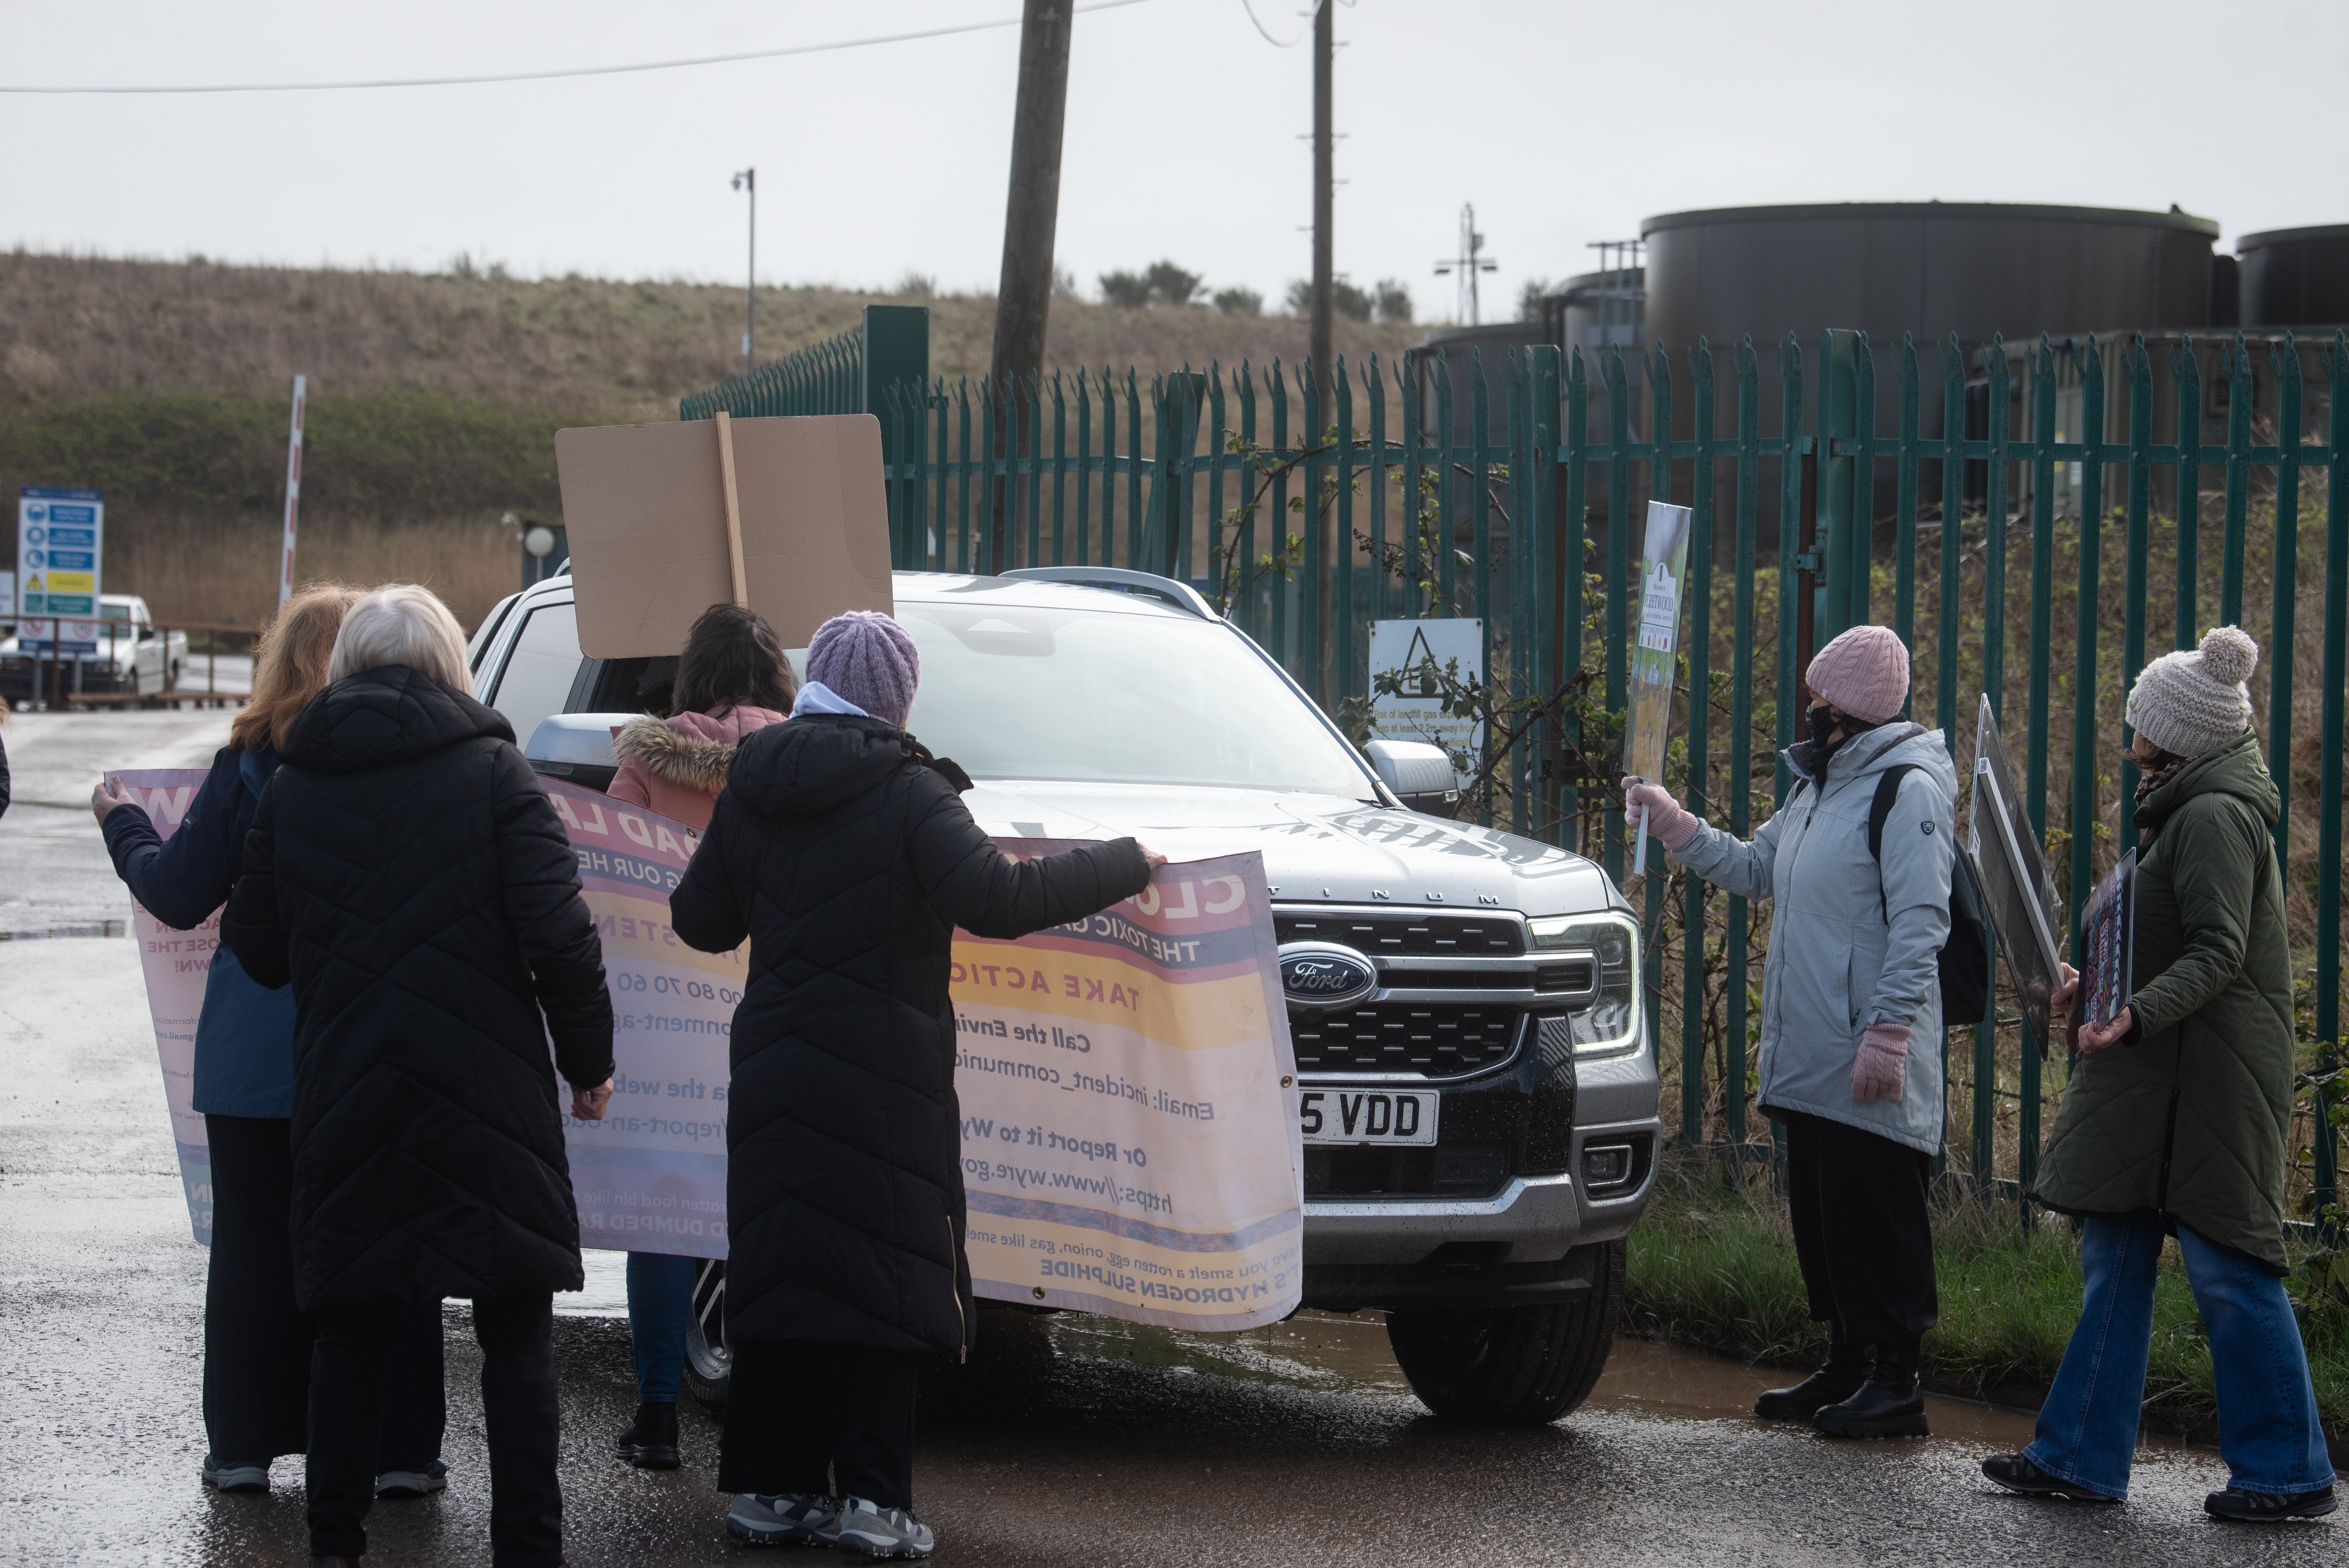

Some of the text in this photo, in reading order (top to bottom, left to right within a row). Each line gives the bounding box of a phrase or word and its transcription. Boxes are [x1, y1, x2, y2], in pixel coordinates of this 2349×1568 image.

[1653, 583, 1663, 591] Welcome
[1644, 594, 1673, 611] FLEETWOOD
[1374, 709, 1387, 719] Risk
[1389, 709, 1396, 719] of
[1398, 709, 1421, 719] landfill
[1424, 711, 1437, 721] gas
[1399, 724, 1417, 733] least
[1419, 724, 1437, 733] 2.2m
[1440, 726, 1458, 735] away
[1460, 724, 1477, 733] from
[1289, 962, 1348, 989] Ford
[1339, 1093, 1420, 1136] VDD
